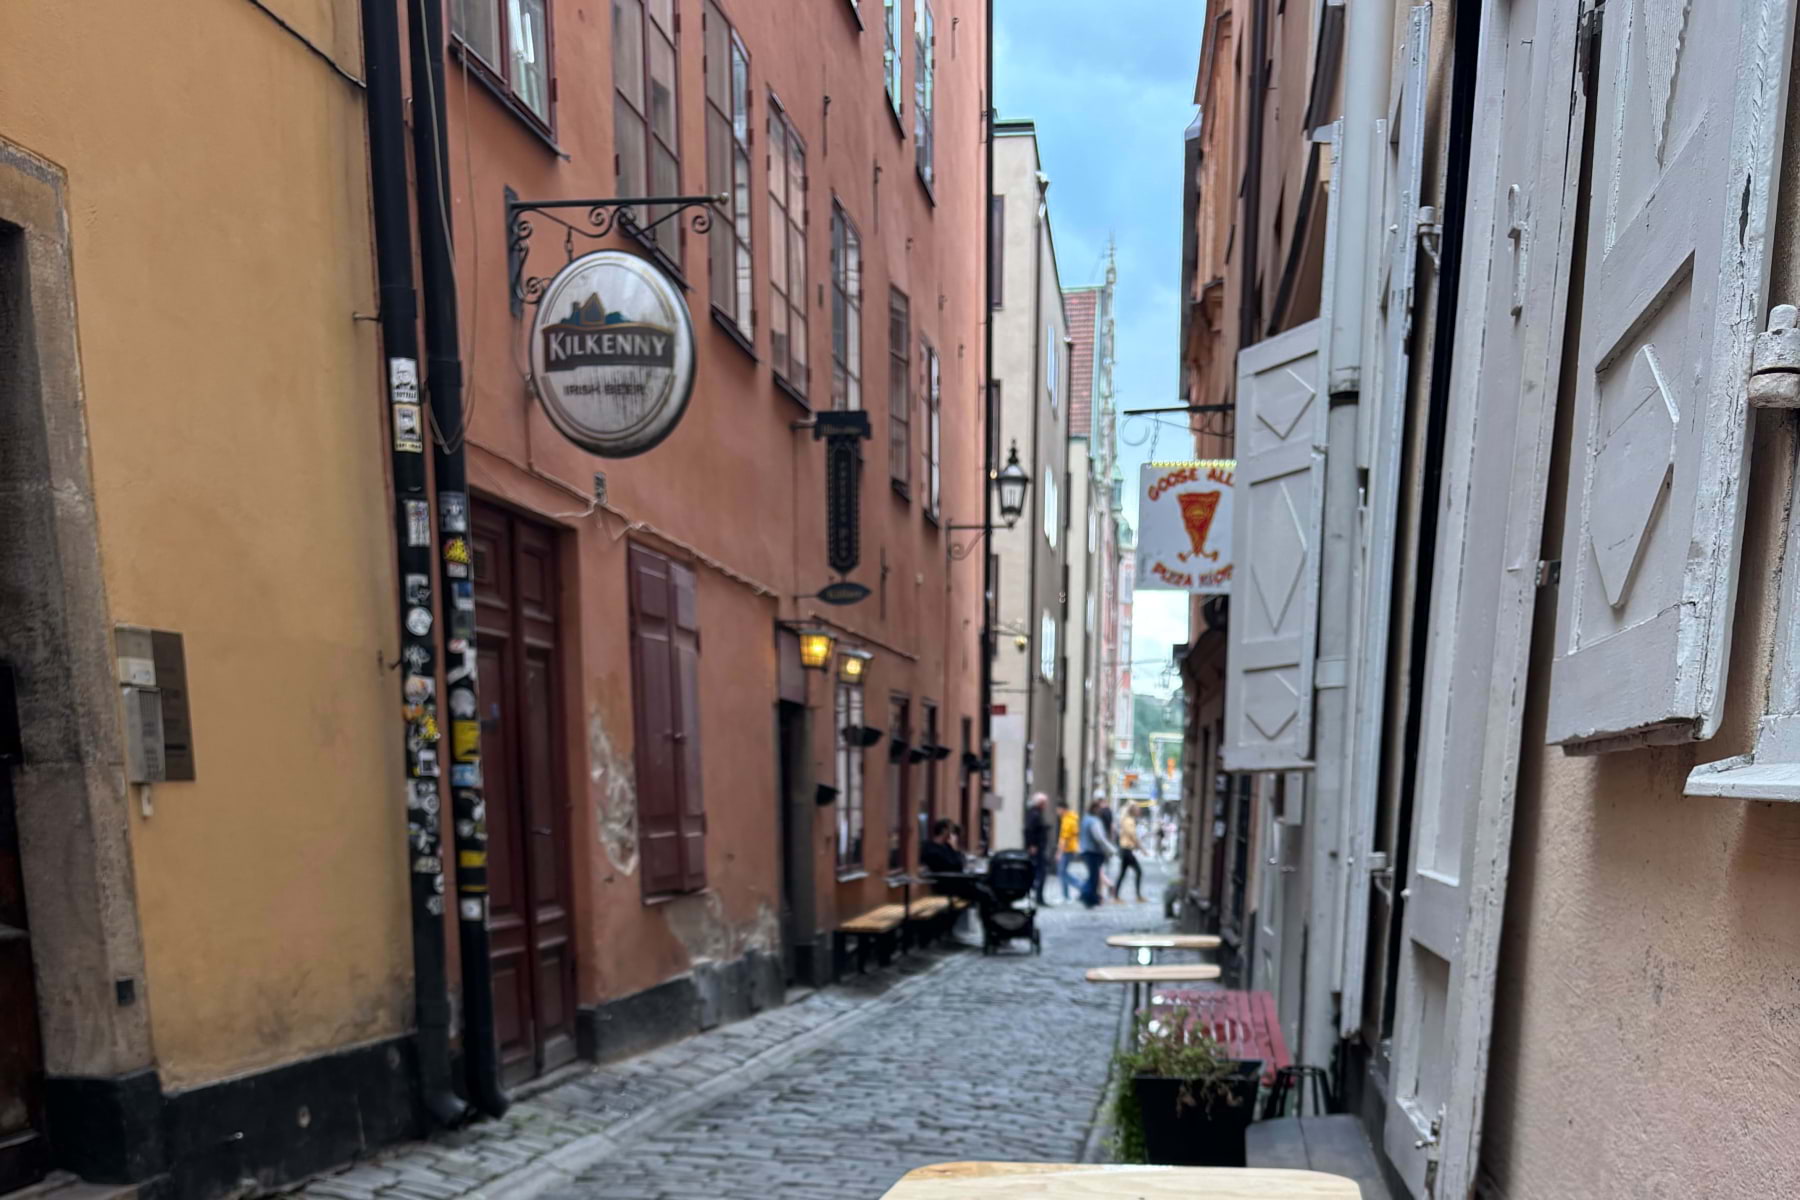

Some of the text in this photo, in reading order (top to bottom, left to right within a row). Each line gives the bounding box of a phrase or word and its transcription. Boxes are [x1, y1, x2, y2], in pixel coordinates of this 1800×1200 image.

[549, 332, 667, 361] KILKENNY
[563, 383, 646, 395] IRISH BEER
[1148, 467, 1198, 501] GOOSE
[1152, 561, 1193, 586] PIZZA
